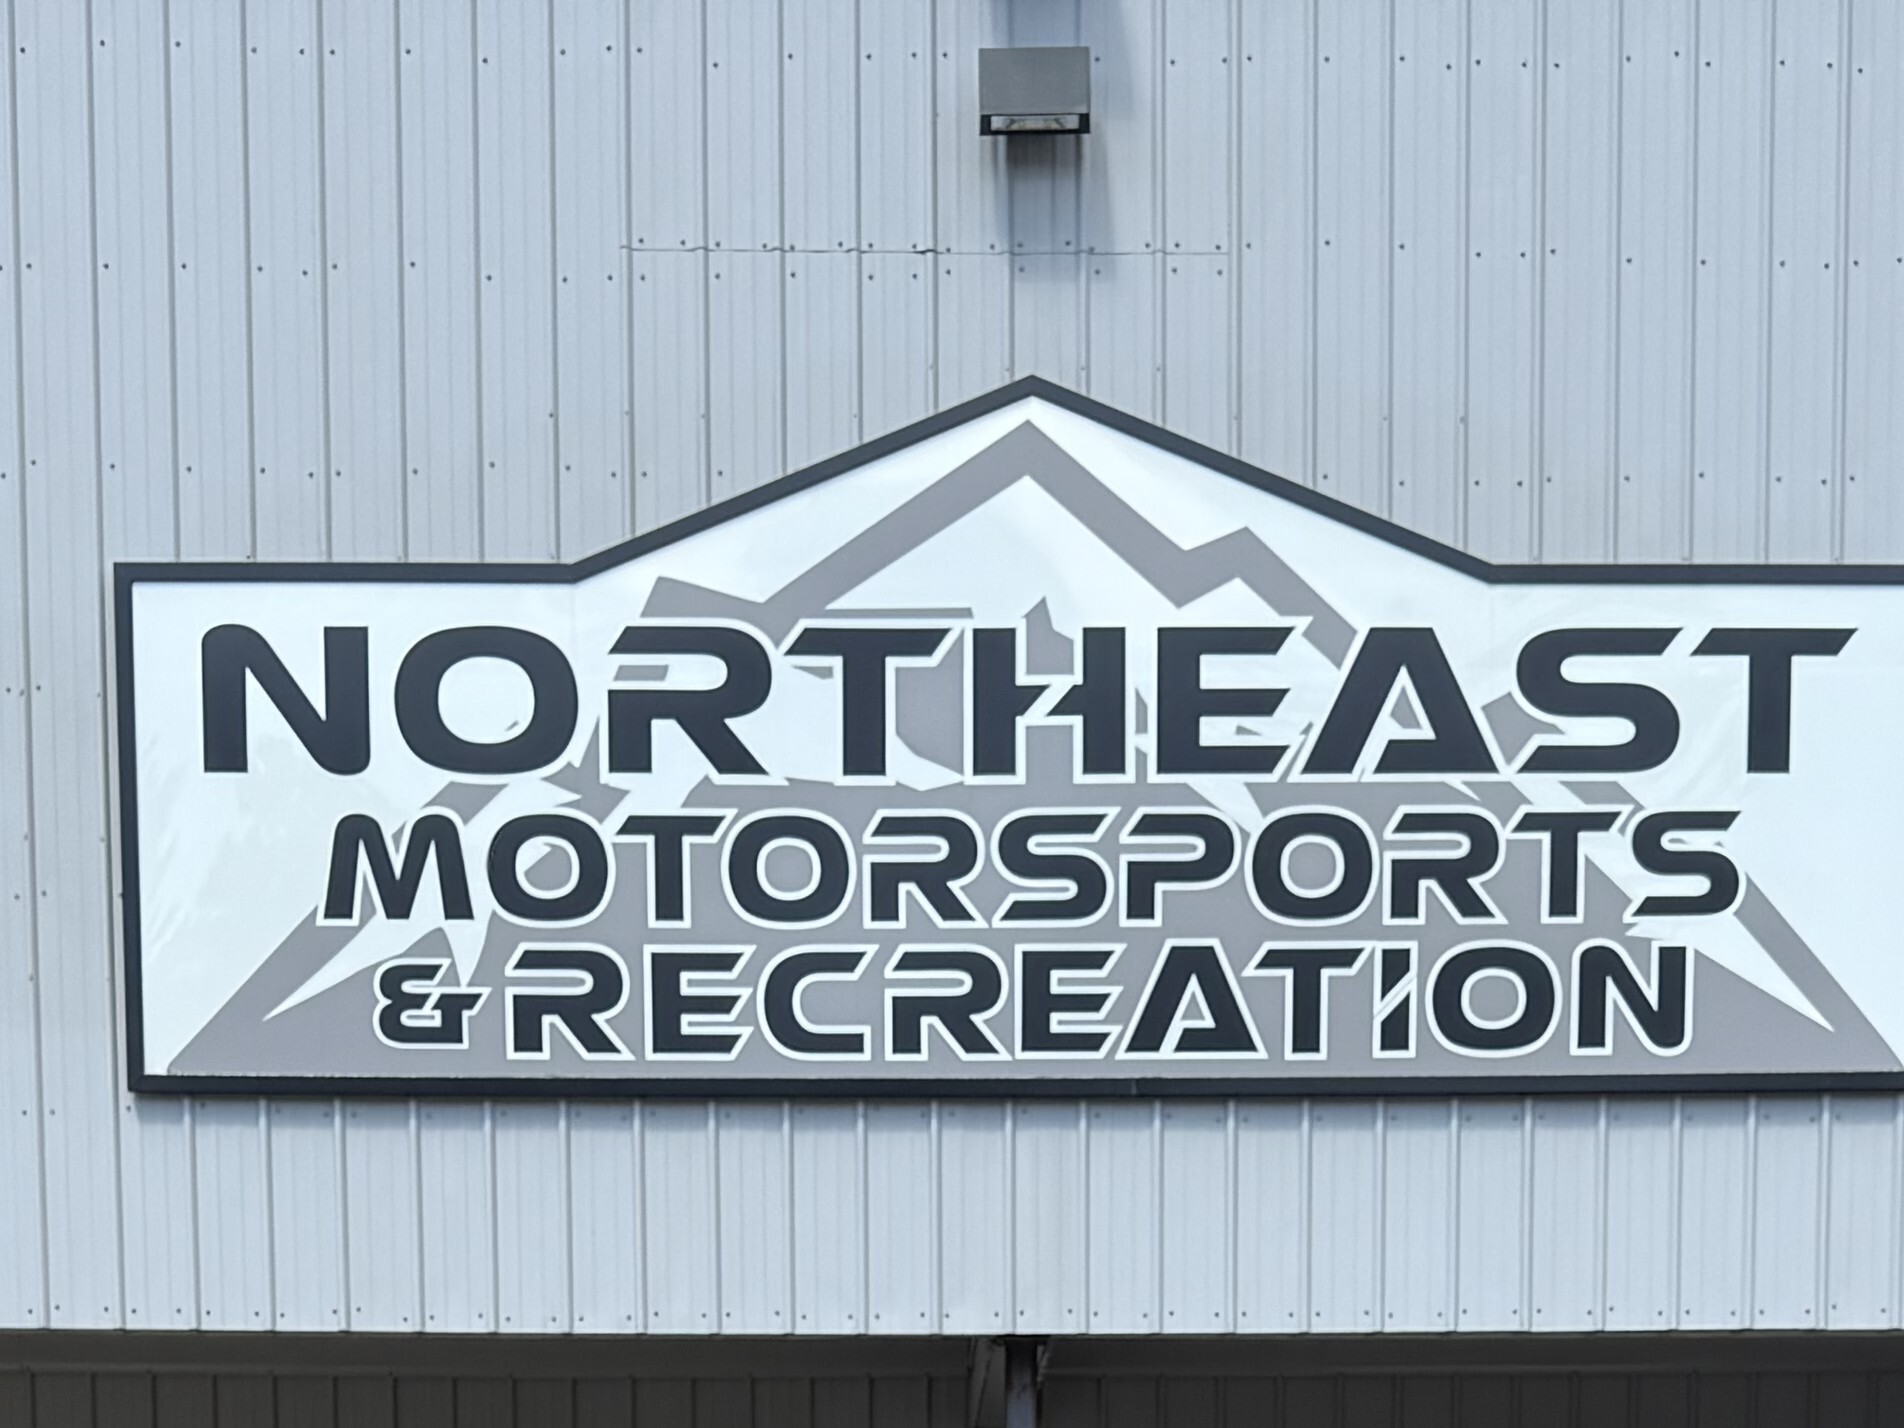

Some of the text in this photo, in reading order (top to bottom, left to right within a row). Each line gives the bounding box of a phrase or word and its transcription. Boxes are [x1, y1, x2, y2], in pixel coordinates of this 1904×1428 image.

[202, 625, 1856, 775] NORTHEAST
[325, 812, 1739, 921] MOTORSPORTS
[513, 946, 1686, 1053] RECREATION
